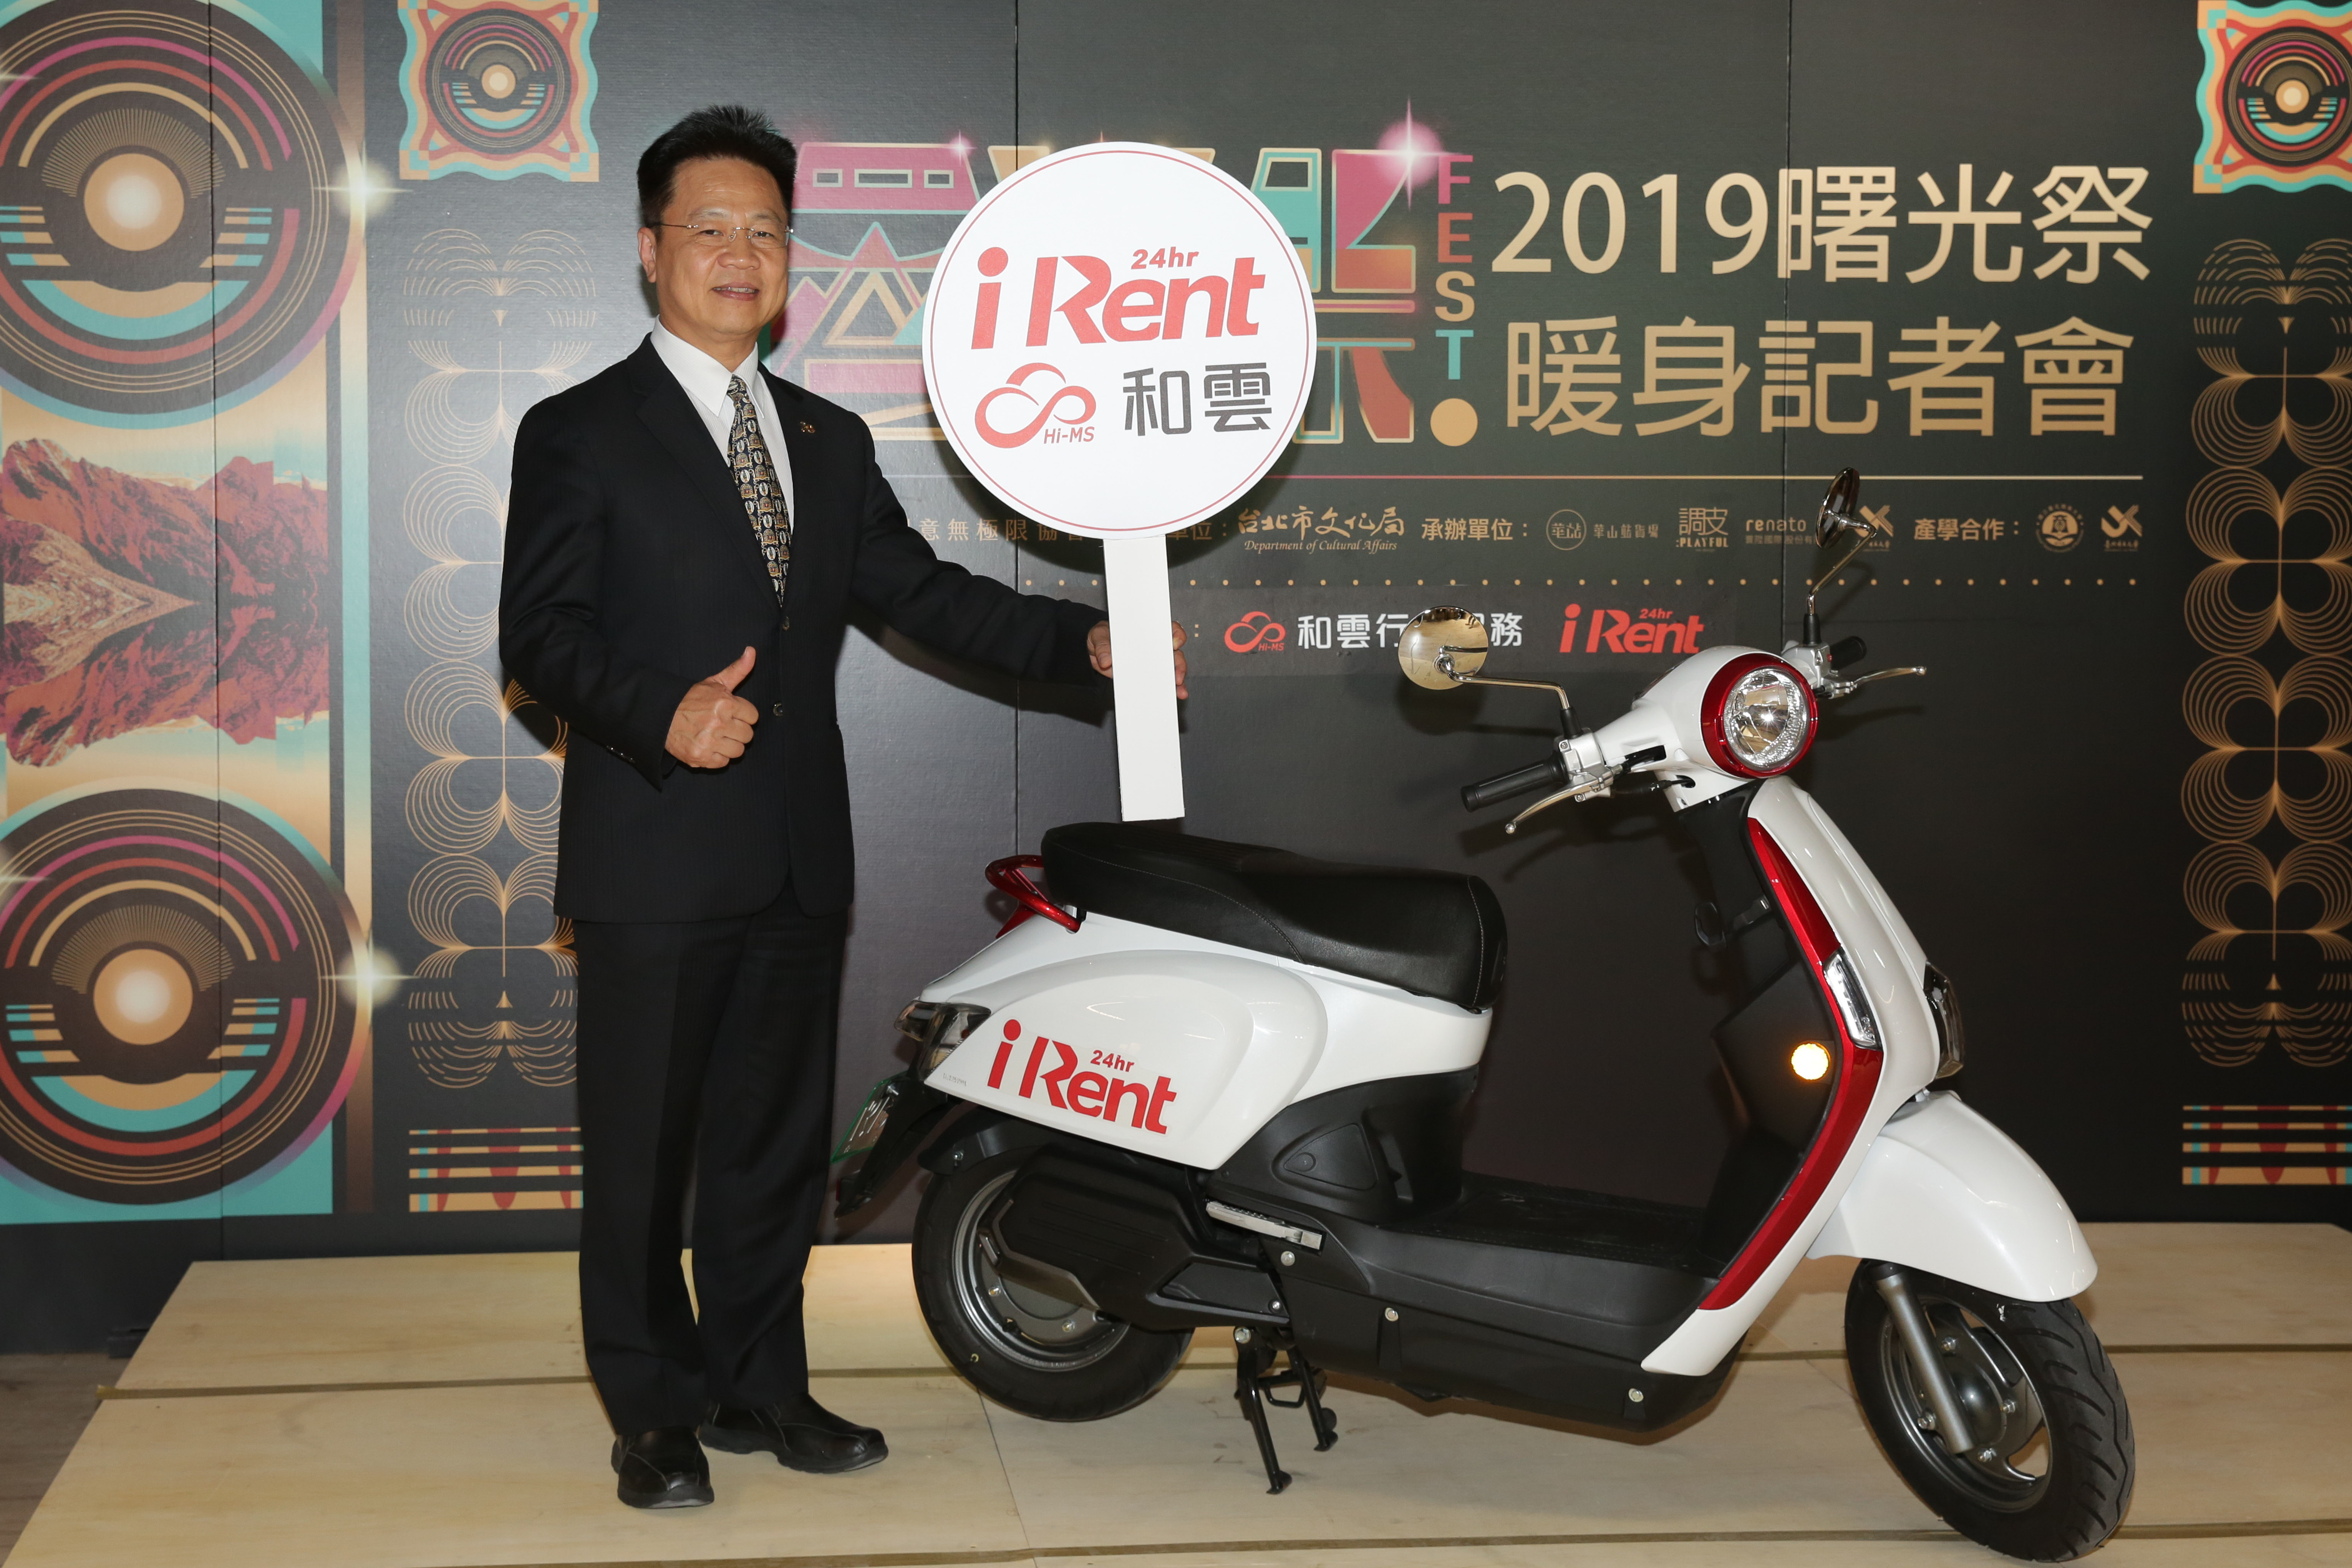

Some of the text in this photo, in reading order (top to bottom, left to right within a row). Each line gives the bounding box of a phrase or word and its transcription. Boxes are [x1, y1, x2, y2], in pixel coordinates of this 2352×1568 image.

[1492, 164, 2153, 284] 2019曙光祭
[1131, 247, 1199, 269] 24hr
[971, 247, 1266, 350] i Rent
[1506, 315, 2135, 437] 暖身記者會
[1123, 362, 1272, 436] 和雲
[1044, 426, 1095, 444] Hi-MS
[1238, 505, 1405, 540] 台北市文化局
[1745, 517, 1807, 532] renato
[1245, 539, 1397, 555] Department of Cultural Affairs
[1559, 603, 1705, 654] i Rent
[1639, 608, 1674, 620] 24hr
[987, 1019, 1177, 1135] i Rent
[1090, 1049, 1135, 1073] 24hr
